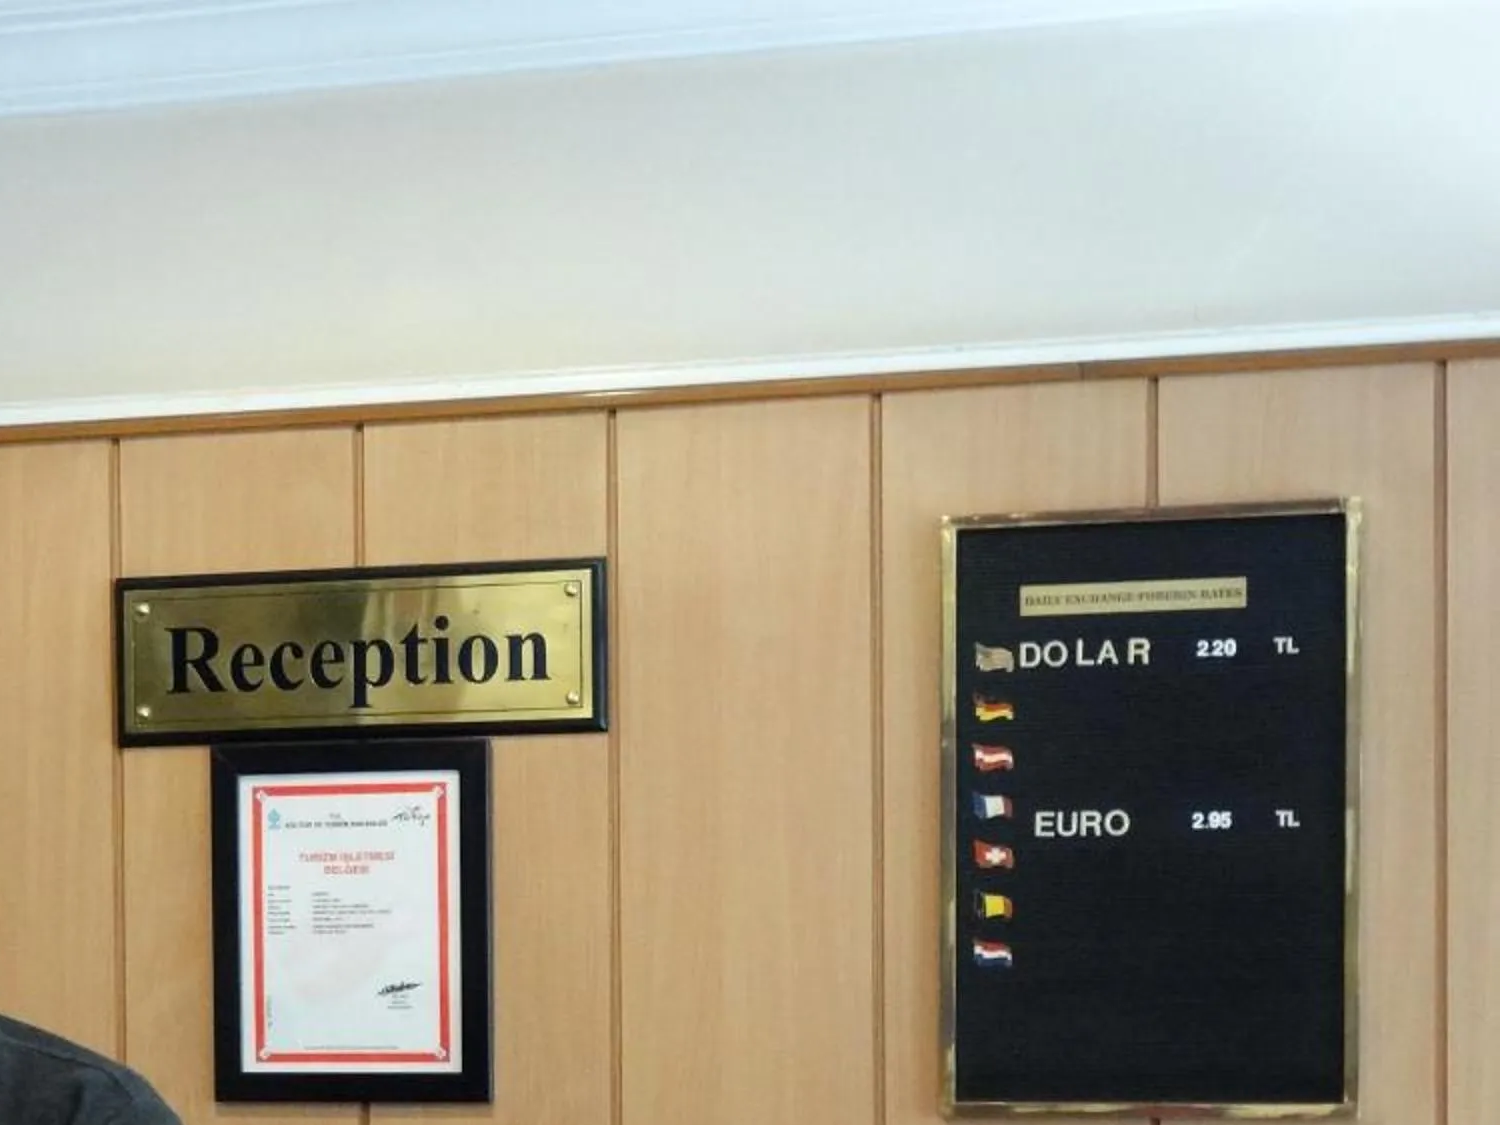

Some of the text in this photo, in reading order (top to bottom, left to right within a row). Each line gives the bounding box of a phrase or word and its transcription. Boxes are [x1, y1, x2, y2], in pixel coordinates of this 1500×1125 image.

[1200, 587, 1243, 600] RATES
[1273, 636, 1300, 655] TL
[164, 614, 552, 709] Reception
[1034, 808, 1131, 838] EURO
[1275, 809, 1301, 828] TL
